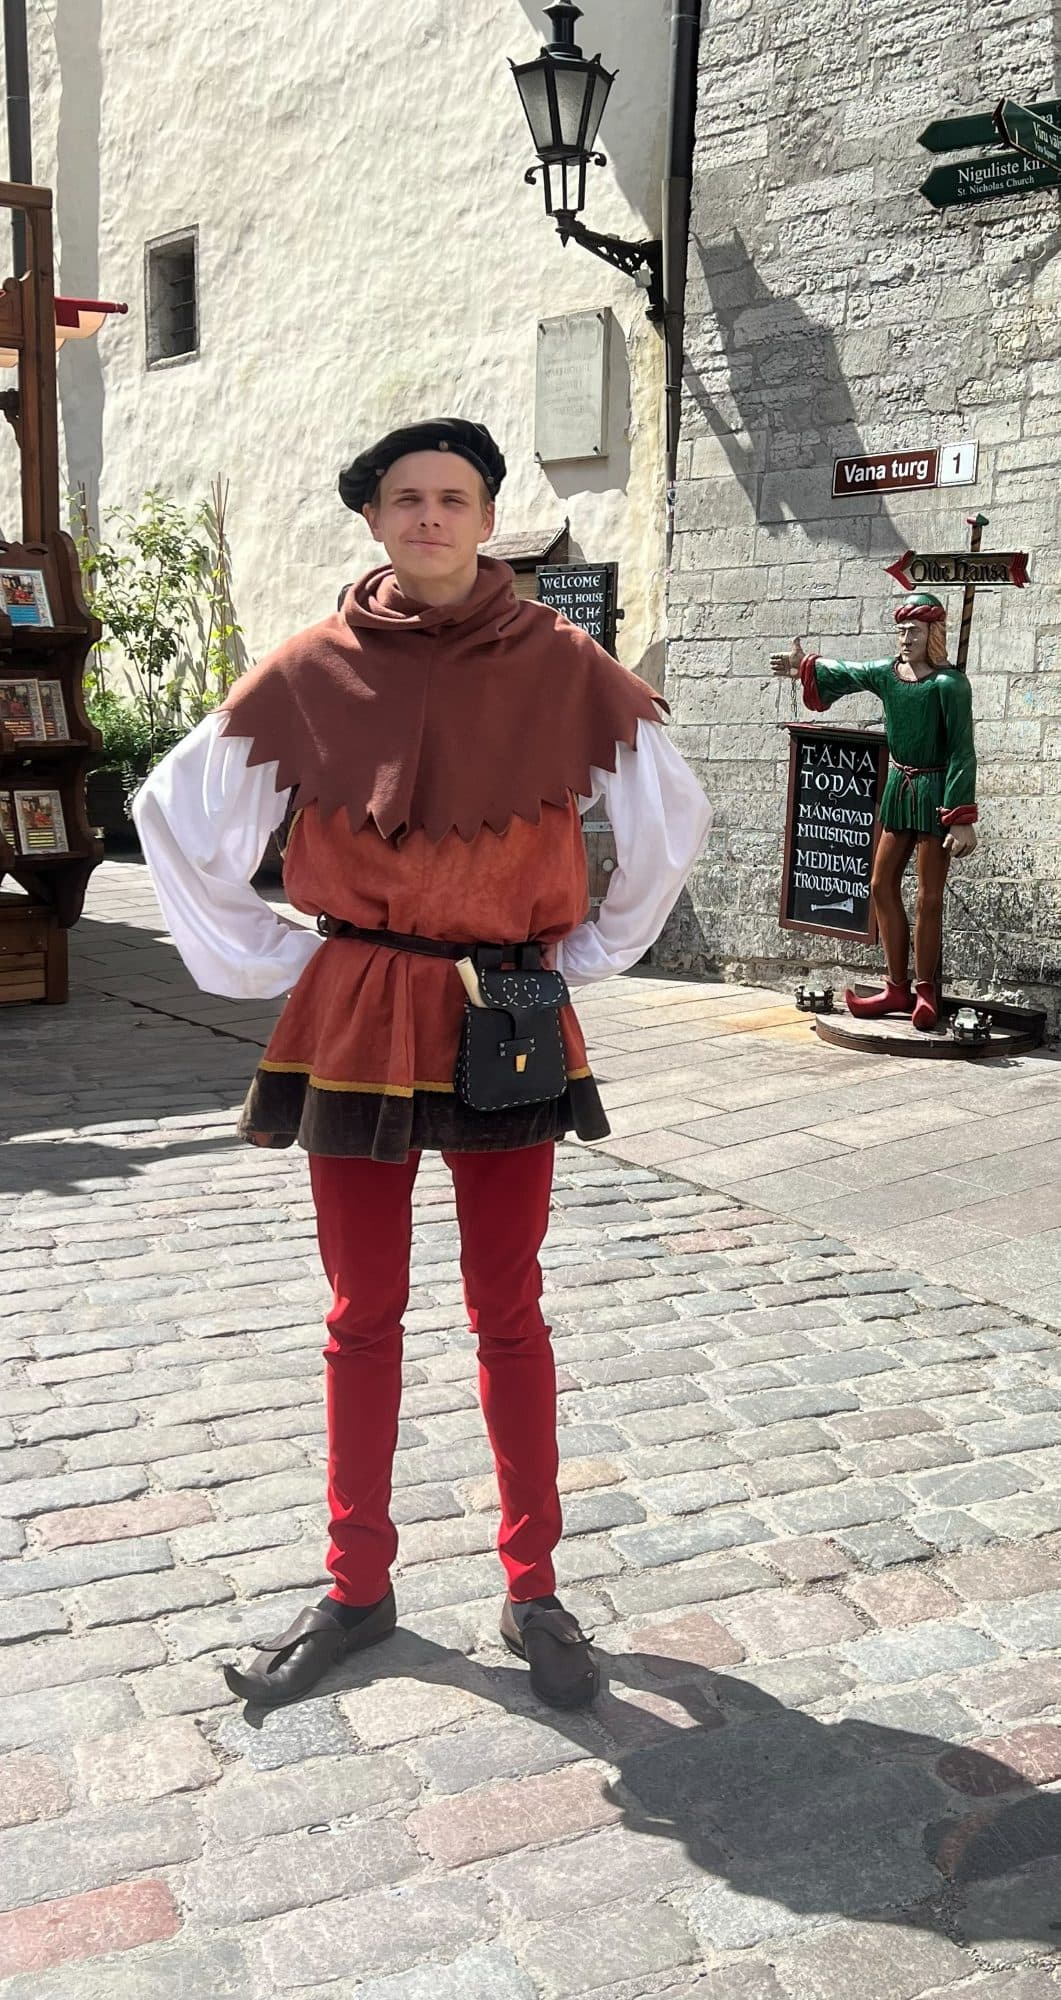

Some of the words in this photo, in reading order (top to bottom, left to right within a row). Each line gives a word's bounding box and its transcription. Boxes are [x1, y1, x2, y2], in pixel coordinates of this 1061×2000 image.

[957, 161, 1020, 184] Niguliste
[969, 180, 1004, 194] Nicholas
[1006, 175, 1034, 188] Church
[844, 463, 886, 483] Vana
[892, 459, 929, 480] turg
[952, 452, 961, 474] 1
[910, 559, 949, 582] Olde
[950, 554, 1010, 582] Hansa
[542, 575, 601, 589] WELCOME
[542, 595, 554, 605] TO
[555, 594, 573, 604] THE
[575, 592, 604, 603] HOUSE
[801, 769, 876, 804] TODAY
[798, 801, 874, 826] MÄNGIVAD
[796, 822, 870, 847] MUUSIKUD
[793, 870, 870, 899] TROUBADURS
